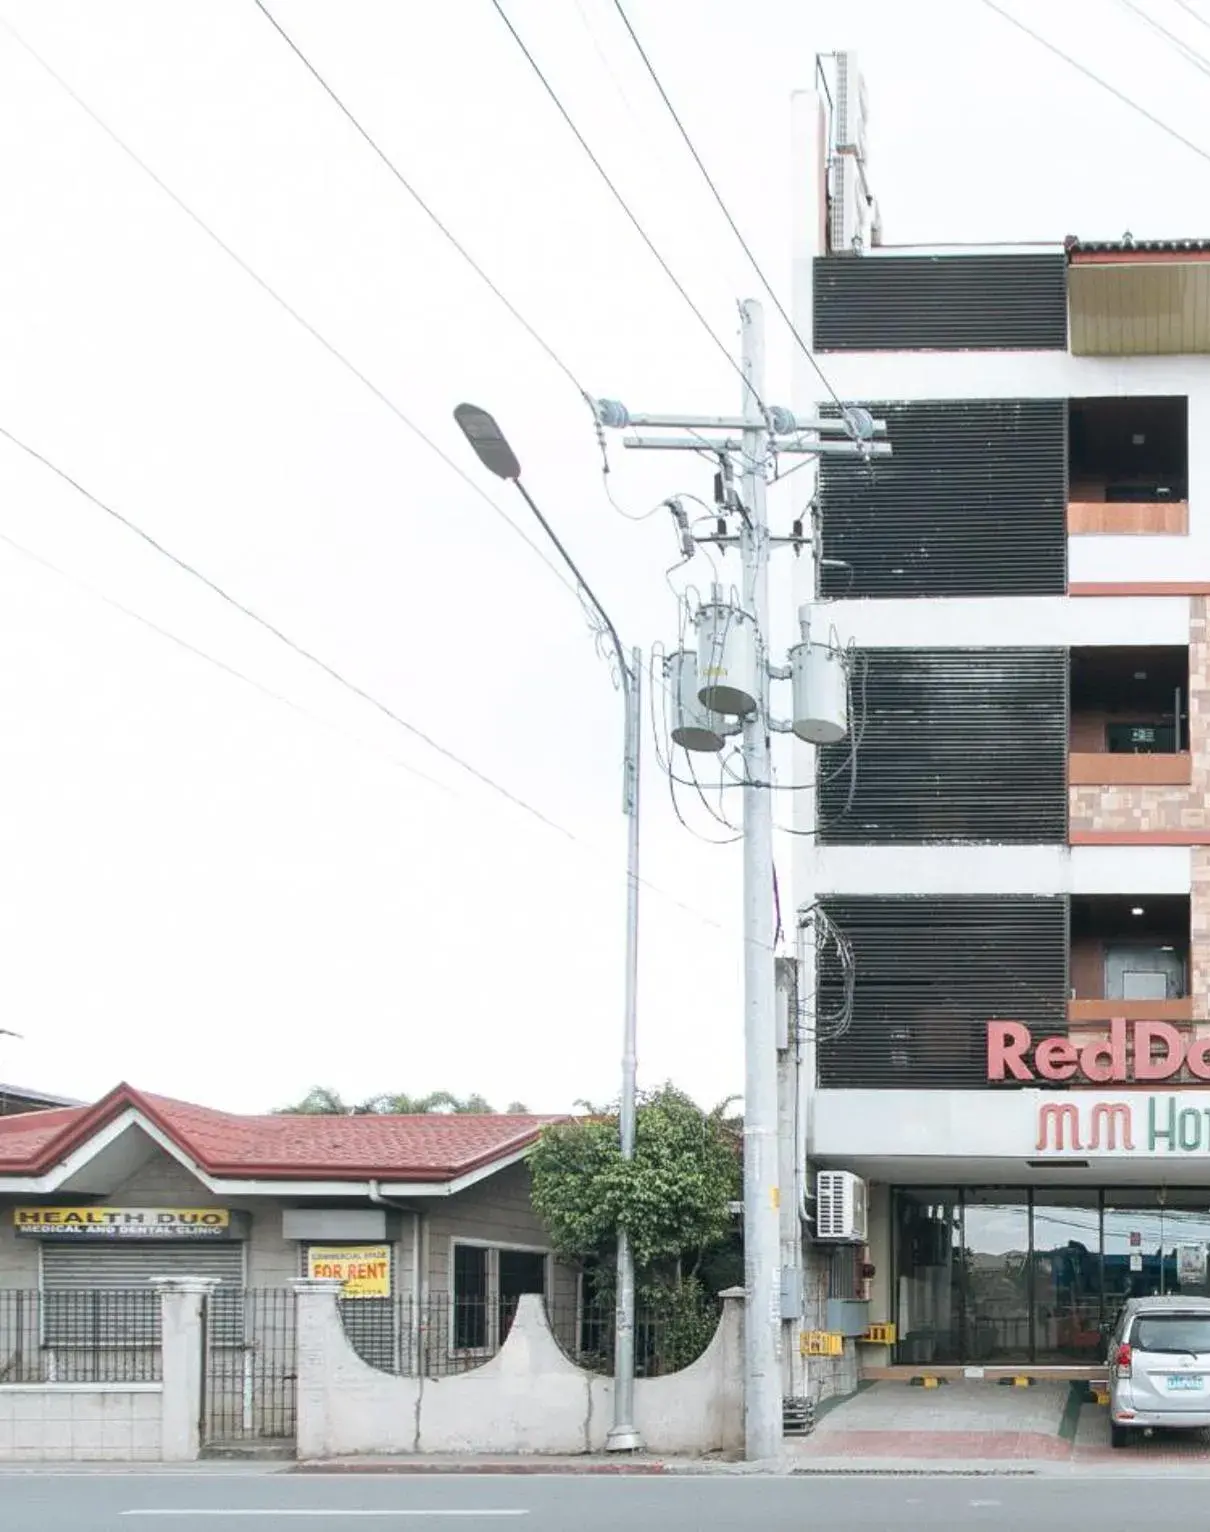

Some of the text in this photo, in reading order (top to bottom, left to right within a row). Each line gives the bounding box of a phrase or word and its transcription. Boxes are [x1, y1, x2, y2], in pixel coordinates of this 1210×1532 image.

[19, 1211, 223, 1224] HEALTH DUO
[20, 1224, 223, 1235] MEDICAL AND DENTAL CLINIC
[313, 1262, 388, 1279] FOR RENT
